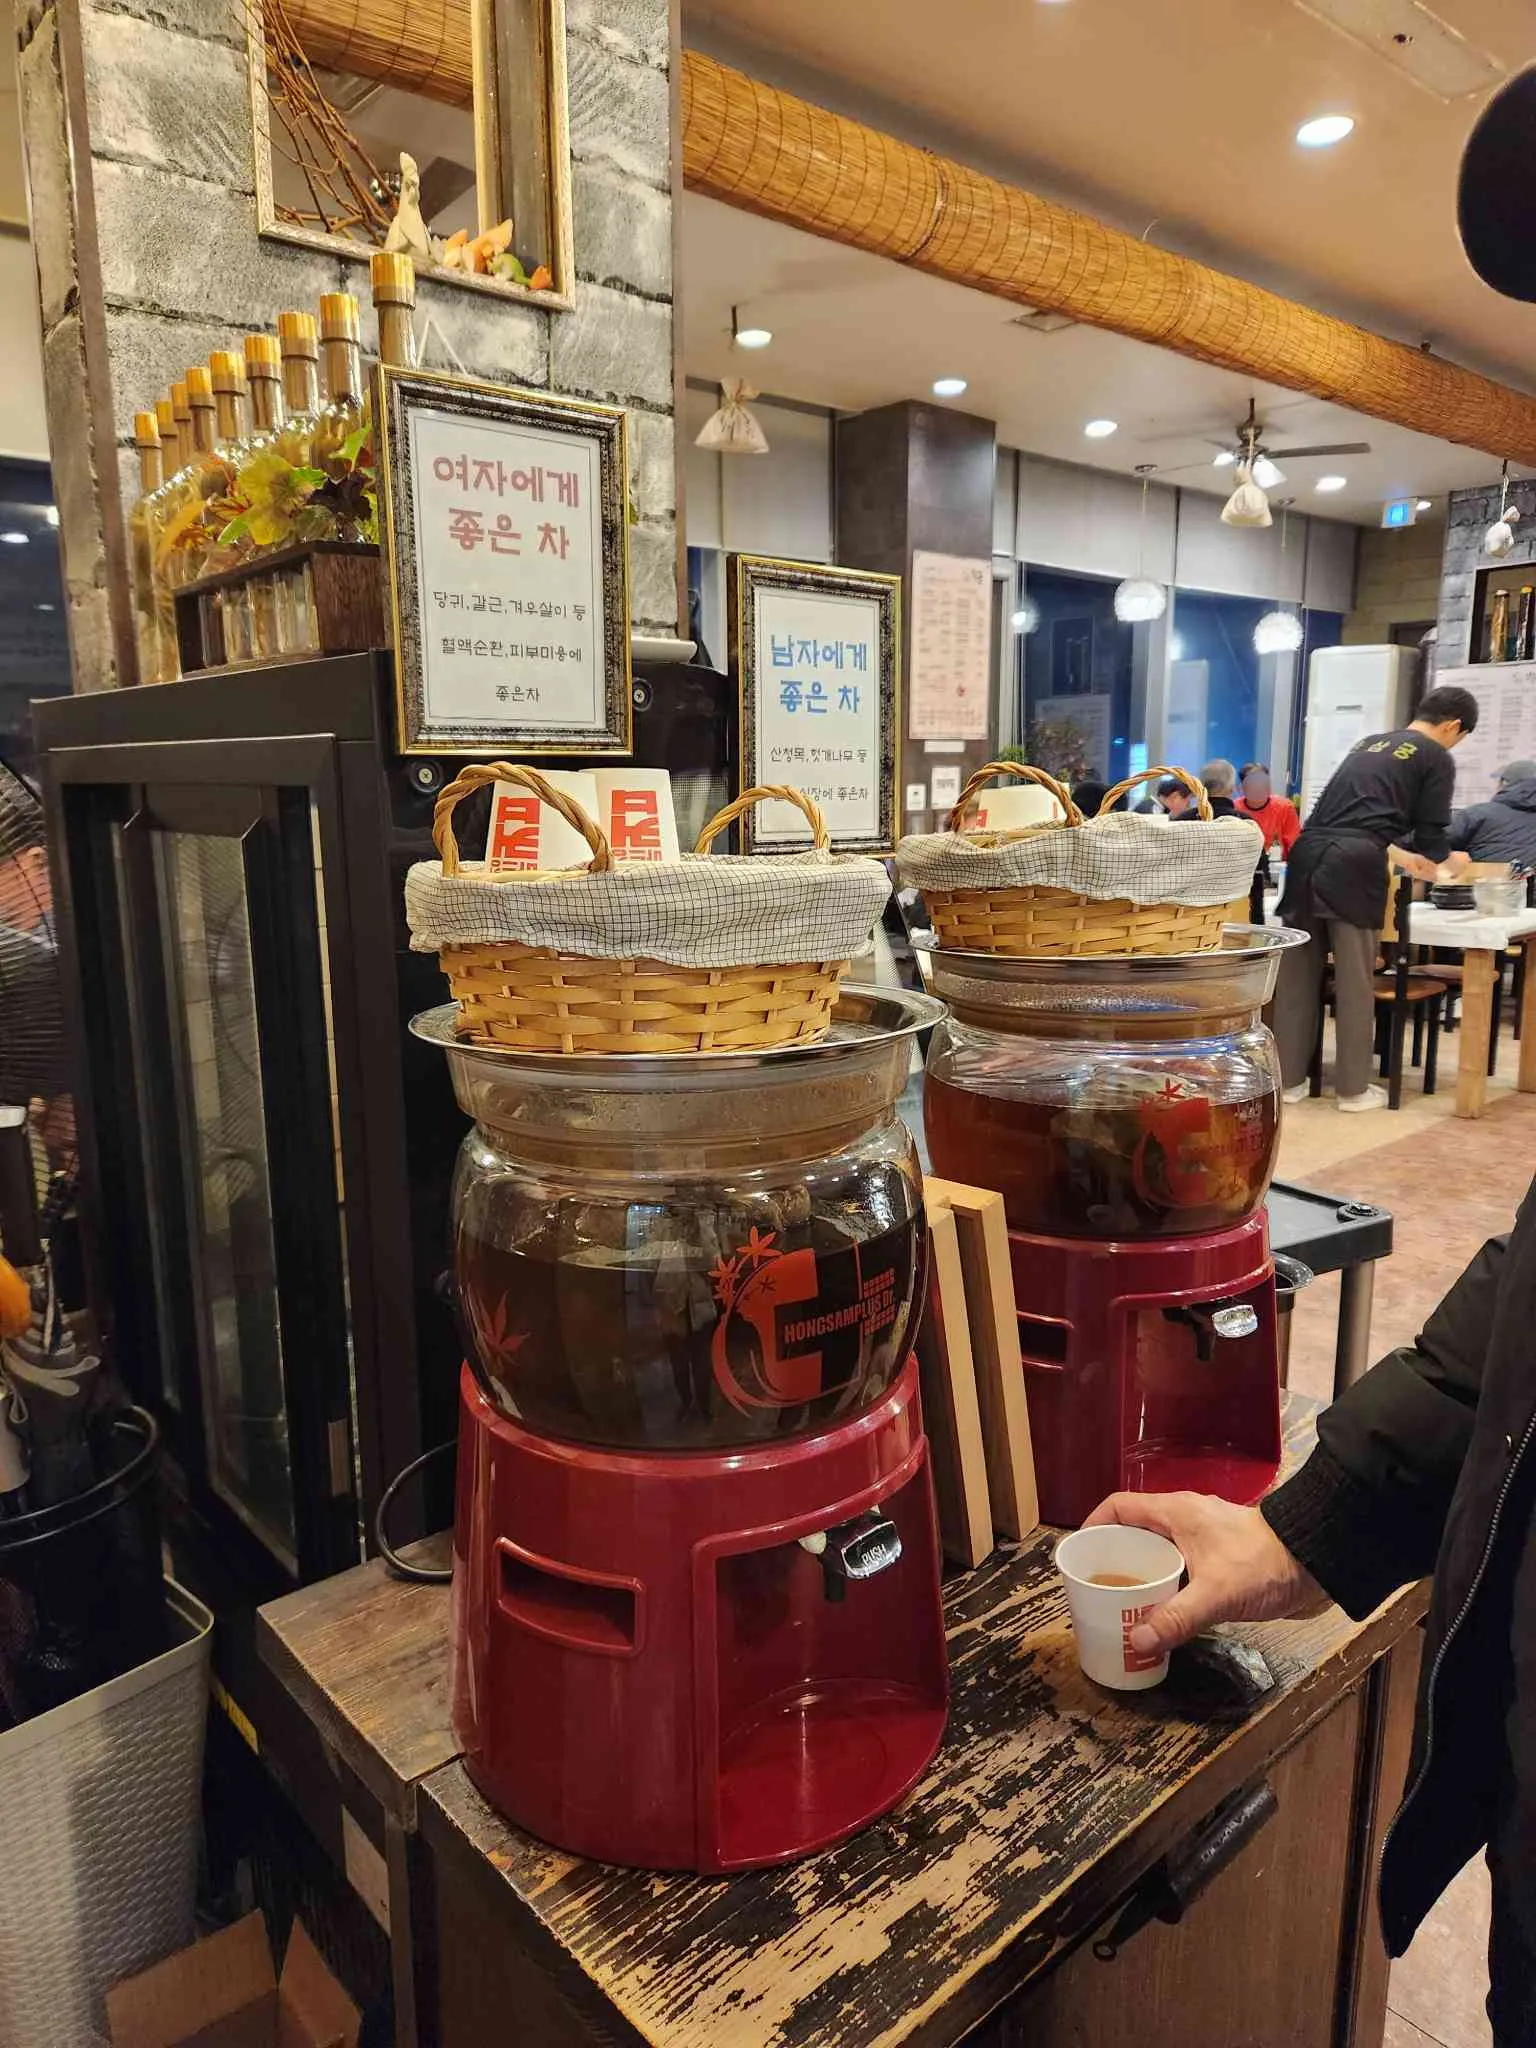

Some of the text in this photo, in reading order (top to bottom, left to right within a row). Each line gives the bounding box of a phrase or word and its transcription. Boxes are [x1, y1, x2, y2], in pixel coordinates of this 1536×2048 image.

[433, 453, 579, 508] 여자에게
[448, 507, 570, 560] 좋은 차
[573, 604, 586, 621] 등
[770, 634, 867, 672] 남자에게
[495, 685, 541, 703] 좋은차
[780, 679, 860, 714] 좋은 차
[857, 750, 867, 763] 등
[861, 1544, 887, 1567] PUSH
